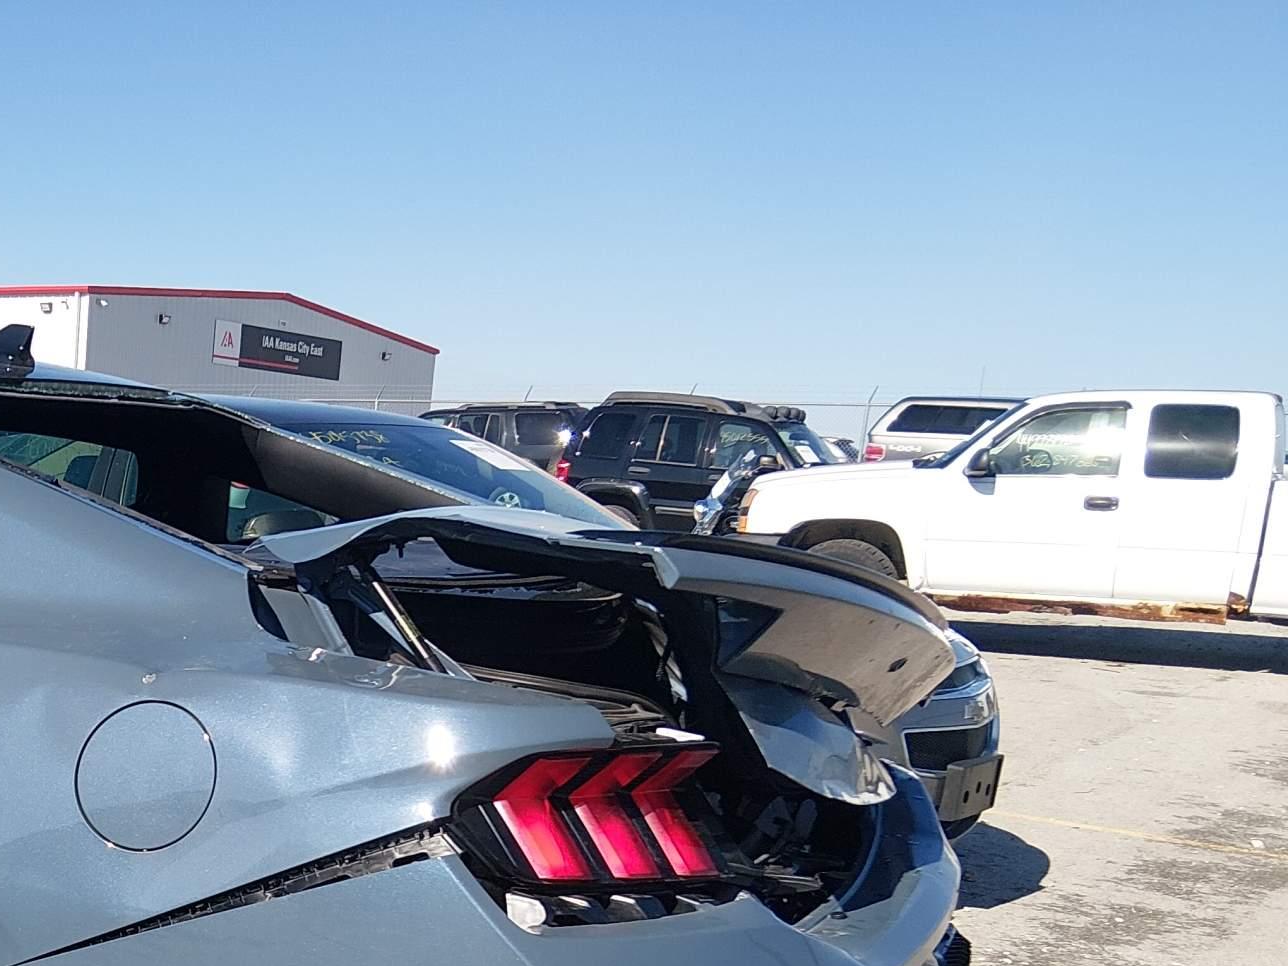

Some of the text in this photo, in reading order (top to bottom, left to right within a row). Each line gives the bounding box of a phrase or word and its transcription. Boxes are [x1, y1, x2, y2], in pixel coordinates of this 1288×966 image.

[262, 335, 323, 357] IAA Kansas City East
